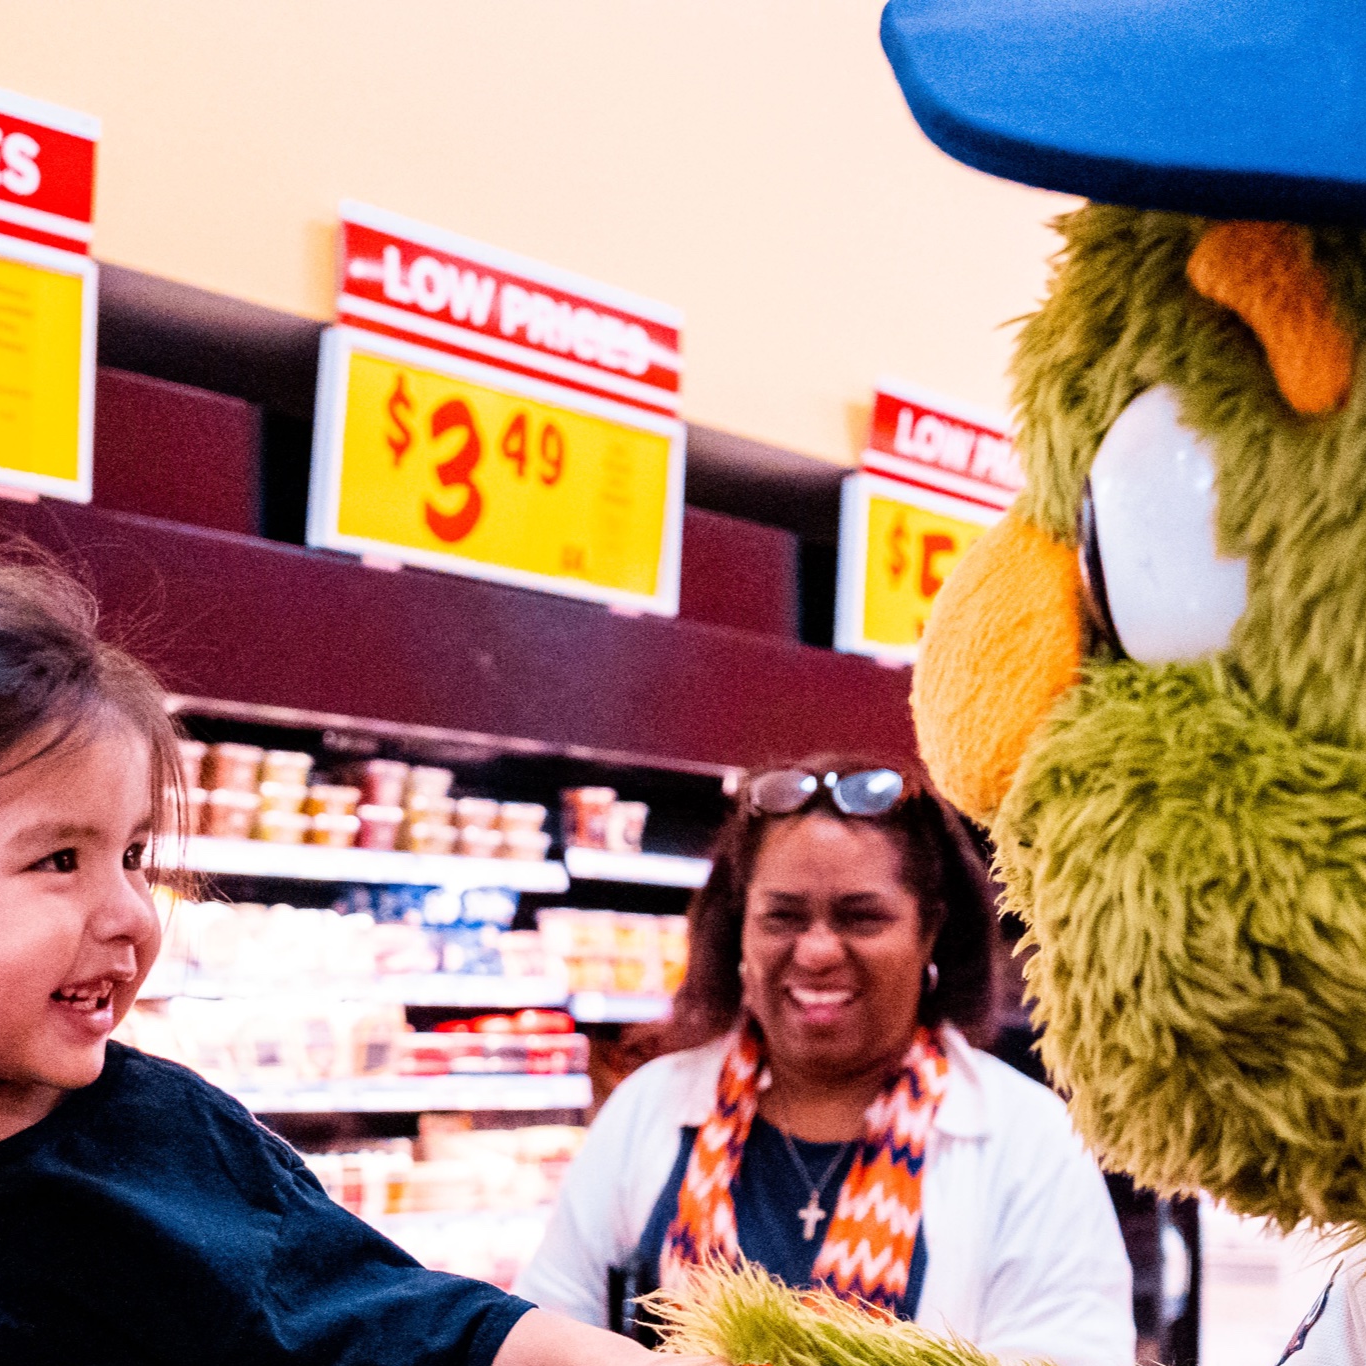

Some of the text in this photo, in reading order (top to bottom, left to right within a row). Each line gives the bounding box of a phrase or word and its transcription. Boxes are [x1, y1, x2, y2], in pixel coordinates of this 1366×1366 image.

[383, 244, 653, 377] LOW PRICES
[893, 406, 977, 472] LOW
